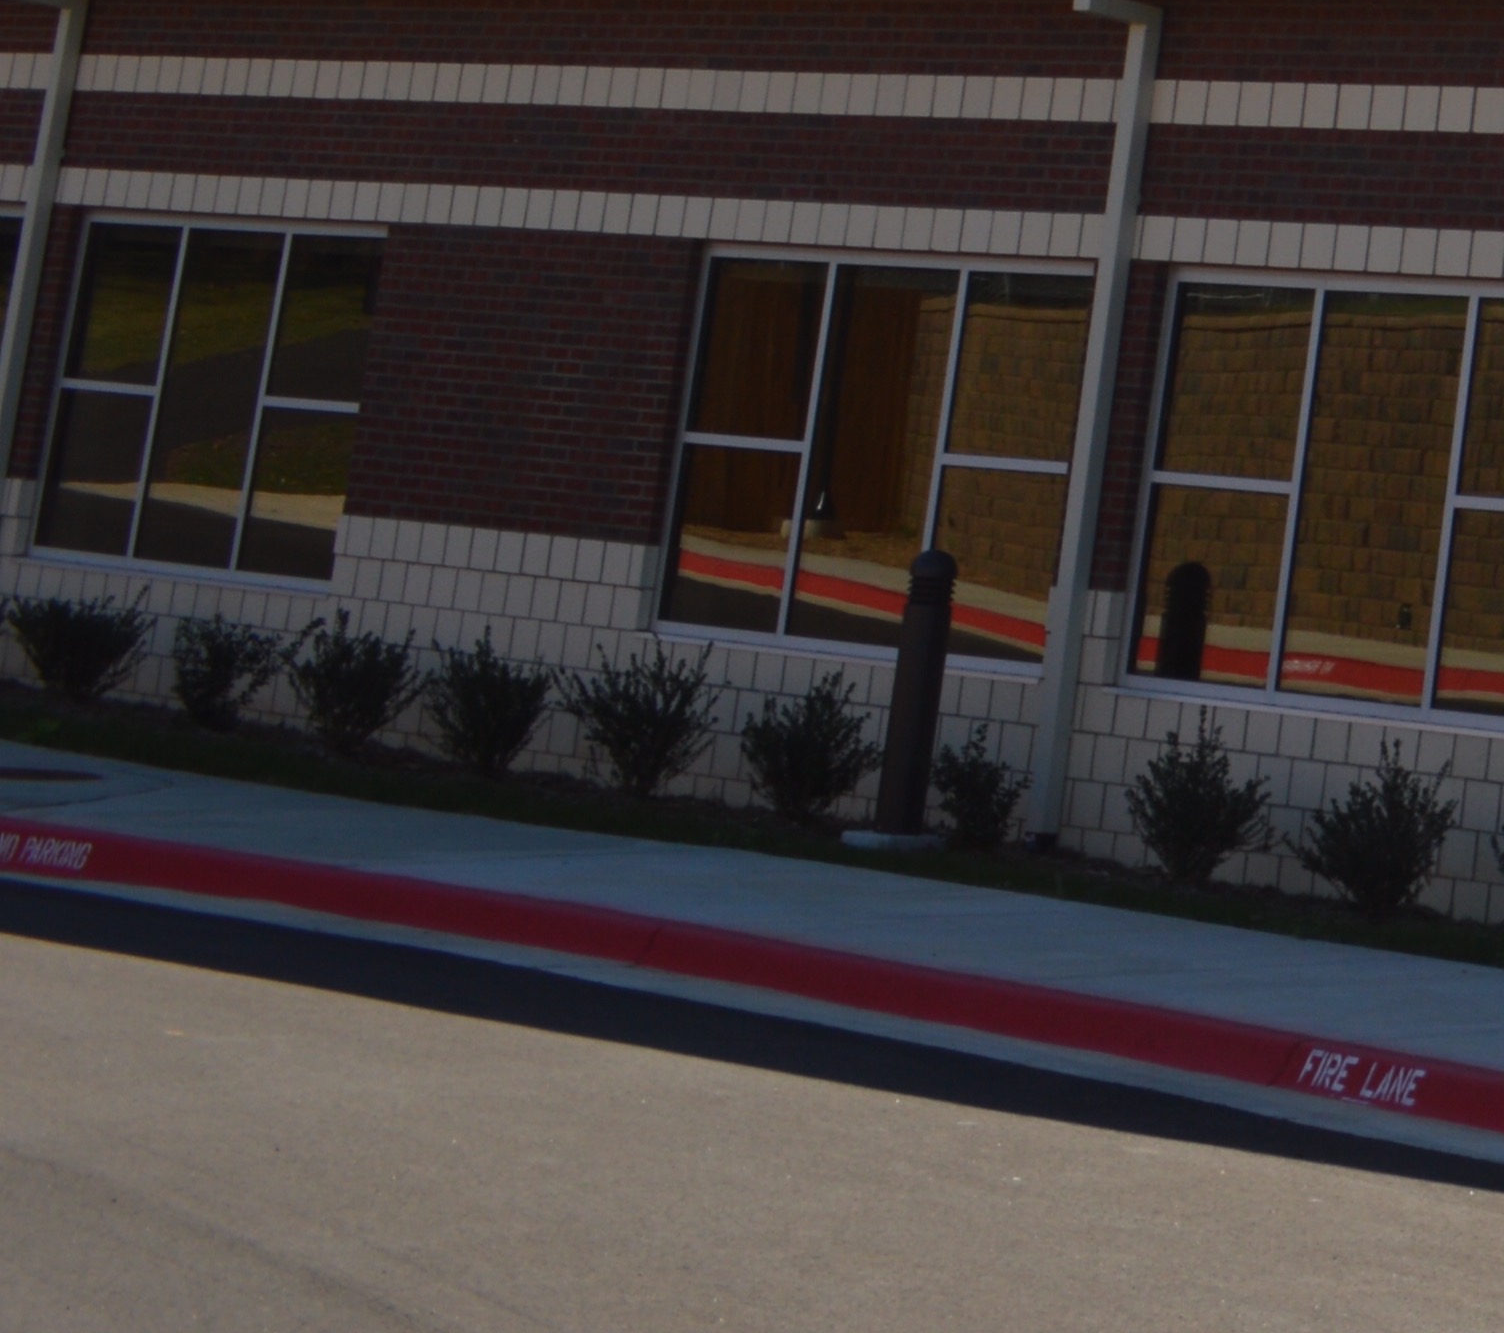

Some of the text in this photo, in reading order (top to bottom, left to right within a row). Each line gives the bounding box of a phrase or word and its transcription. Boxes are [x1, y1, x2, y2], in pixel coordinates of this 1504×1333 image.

[18, 836, 93, 870] PARKING
[1298, 1049, 1425, 1106] FIRE LANE
